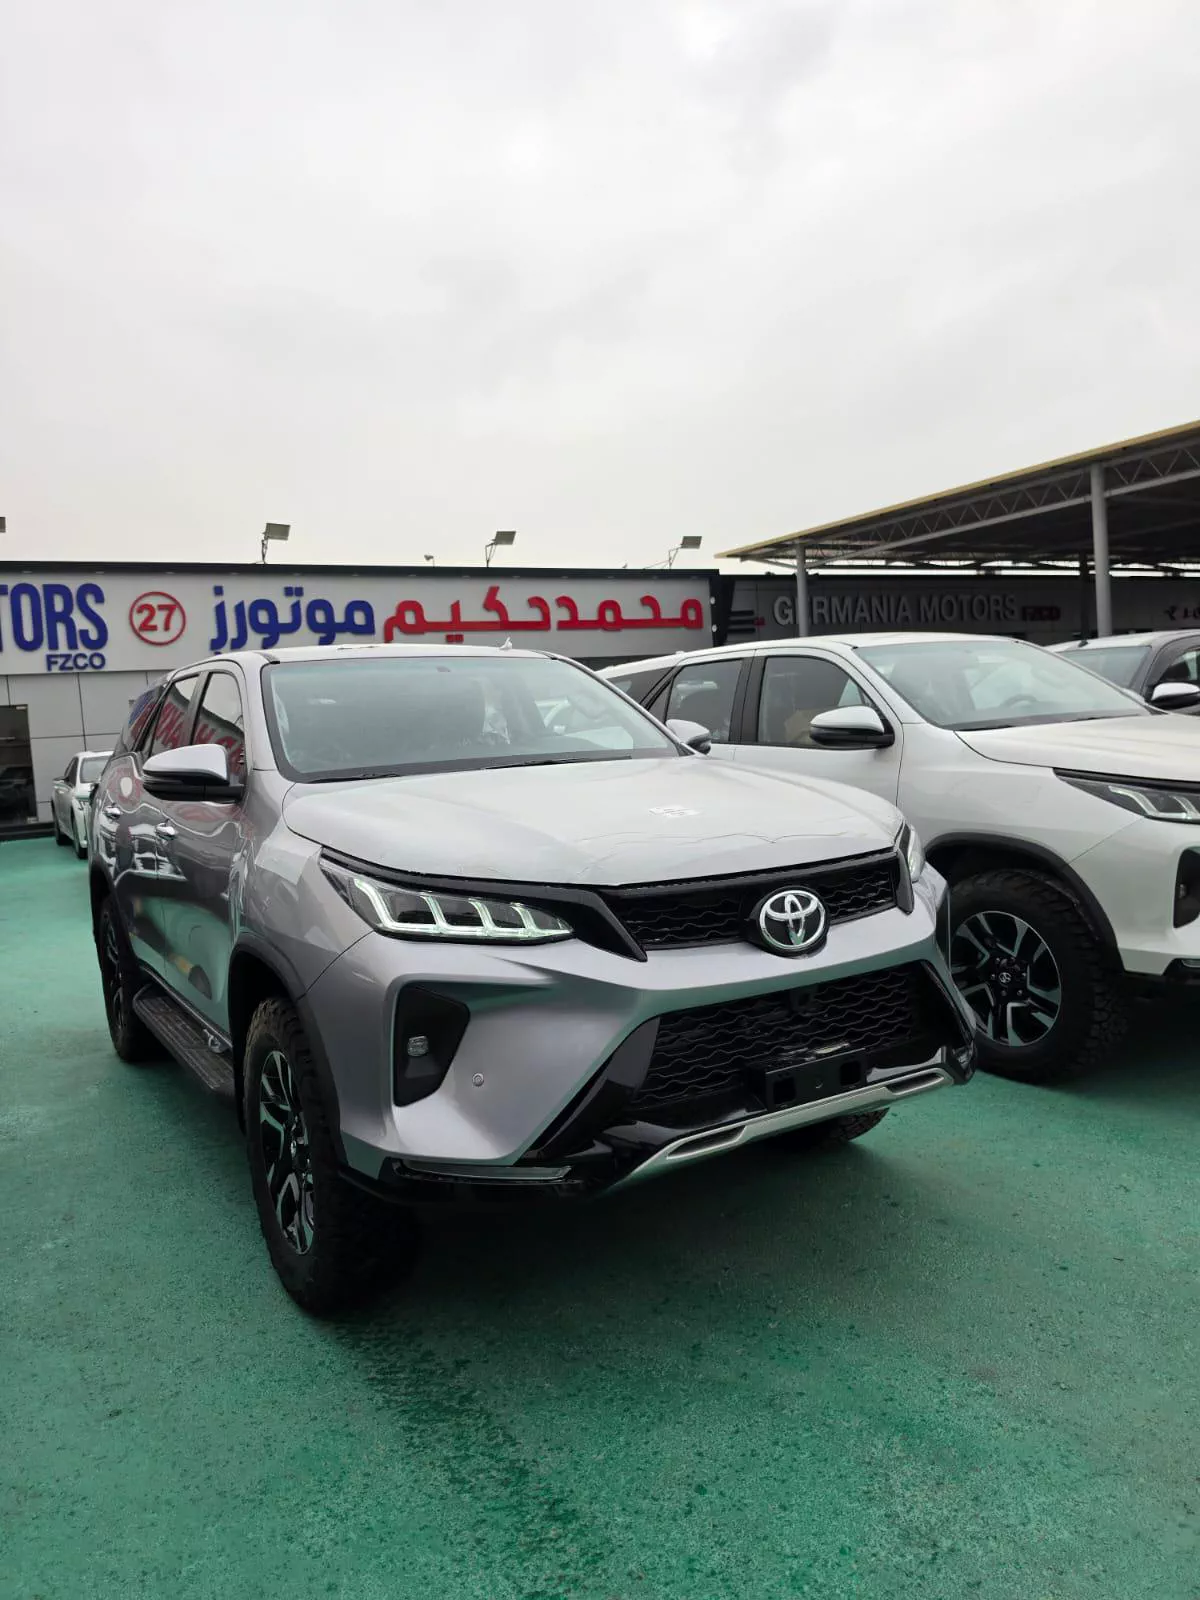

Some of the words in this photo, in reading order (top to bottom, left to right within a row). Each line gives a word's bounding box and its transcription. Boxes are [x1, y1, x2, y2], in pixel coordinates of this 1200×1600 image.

[136, 603, 177, 632] 27
[210, 585, 375, 651] موتورز
[556, 595, 704, 632] محمد
[773, 594, 912, 626] GRMANIA
[919, 593, 1018, 623] MOTORS
[46, 652, 106, 672] FZCO
